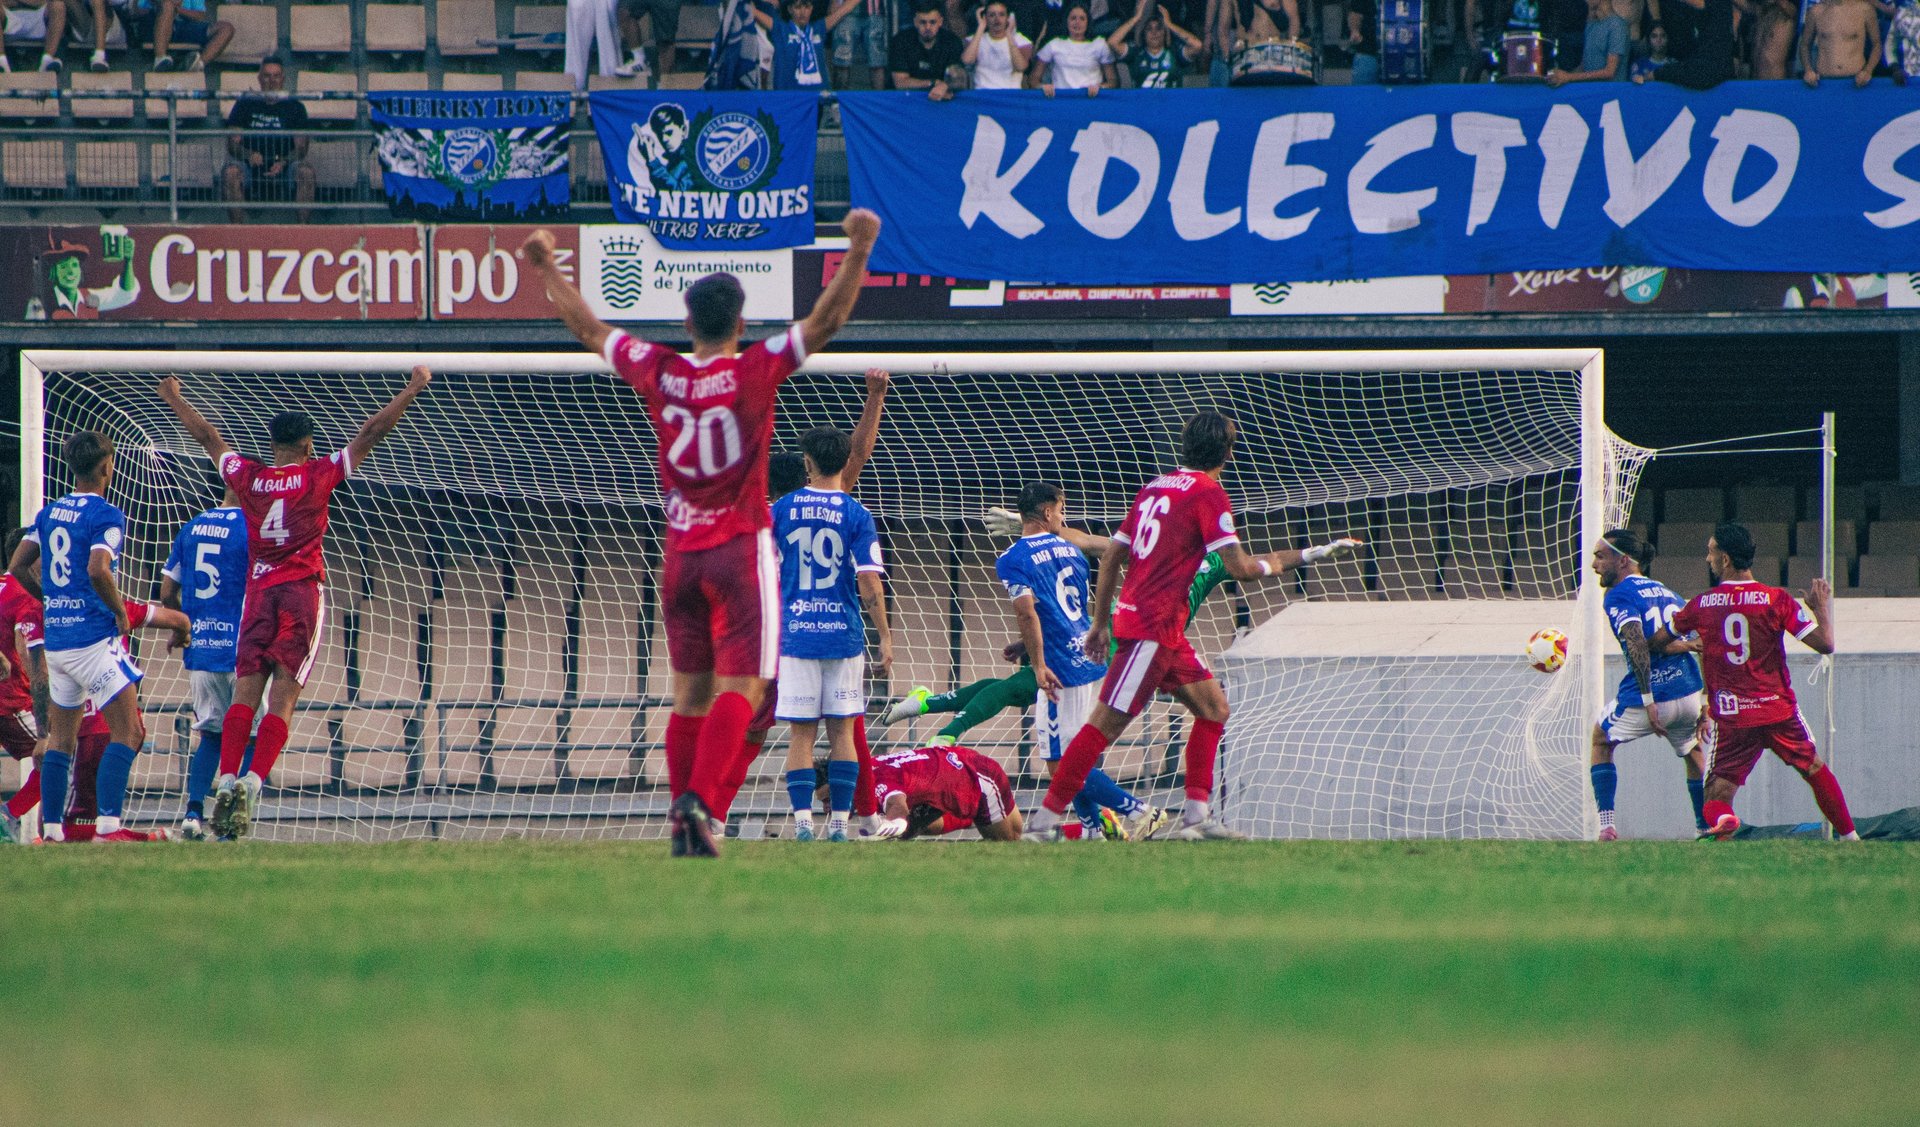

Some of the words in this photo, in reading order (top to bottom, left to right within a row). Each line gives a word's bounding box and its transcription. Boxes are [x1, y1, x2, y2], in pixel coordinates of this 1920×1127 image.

[959, 100, 1800, 241] KOLECTIVO
[658, 191, 730, 219] NEW
[738, 185, 809, 219] ONES
[704, 222, 764, 240] XEREZ
[149, 233, 519, 314] Cruzcampo
[654, 259, 772, 275] Ayuntamiento
[654, 276, 673, 289] de
[661, 404, 742, 479] 20
[191, 524, 230, 539] MAURO
[259, 498, 290, 546] 4
[1132, 495, 1171, 560] 16
[48, 526, 72, 588] 8
[194, 542, 221, 600] 5
[785, 526, 844, 590] 19
[1056, 565, 1083, 622] 6
[1744, 590, 1771, 605] MESA
[208, 637, 234, 647] benito
[799, 621, 816, 629] san
[817, 620, 848, 630] benito
[1724, 612, 1751, 665] 9
